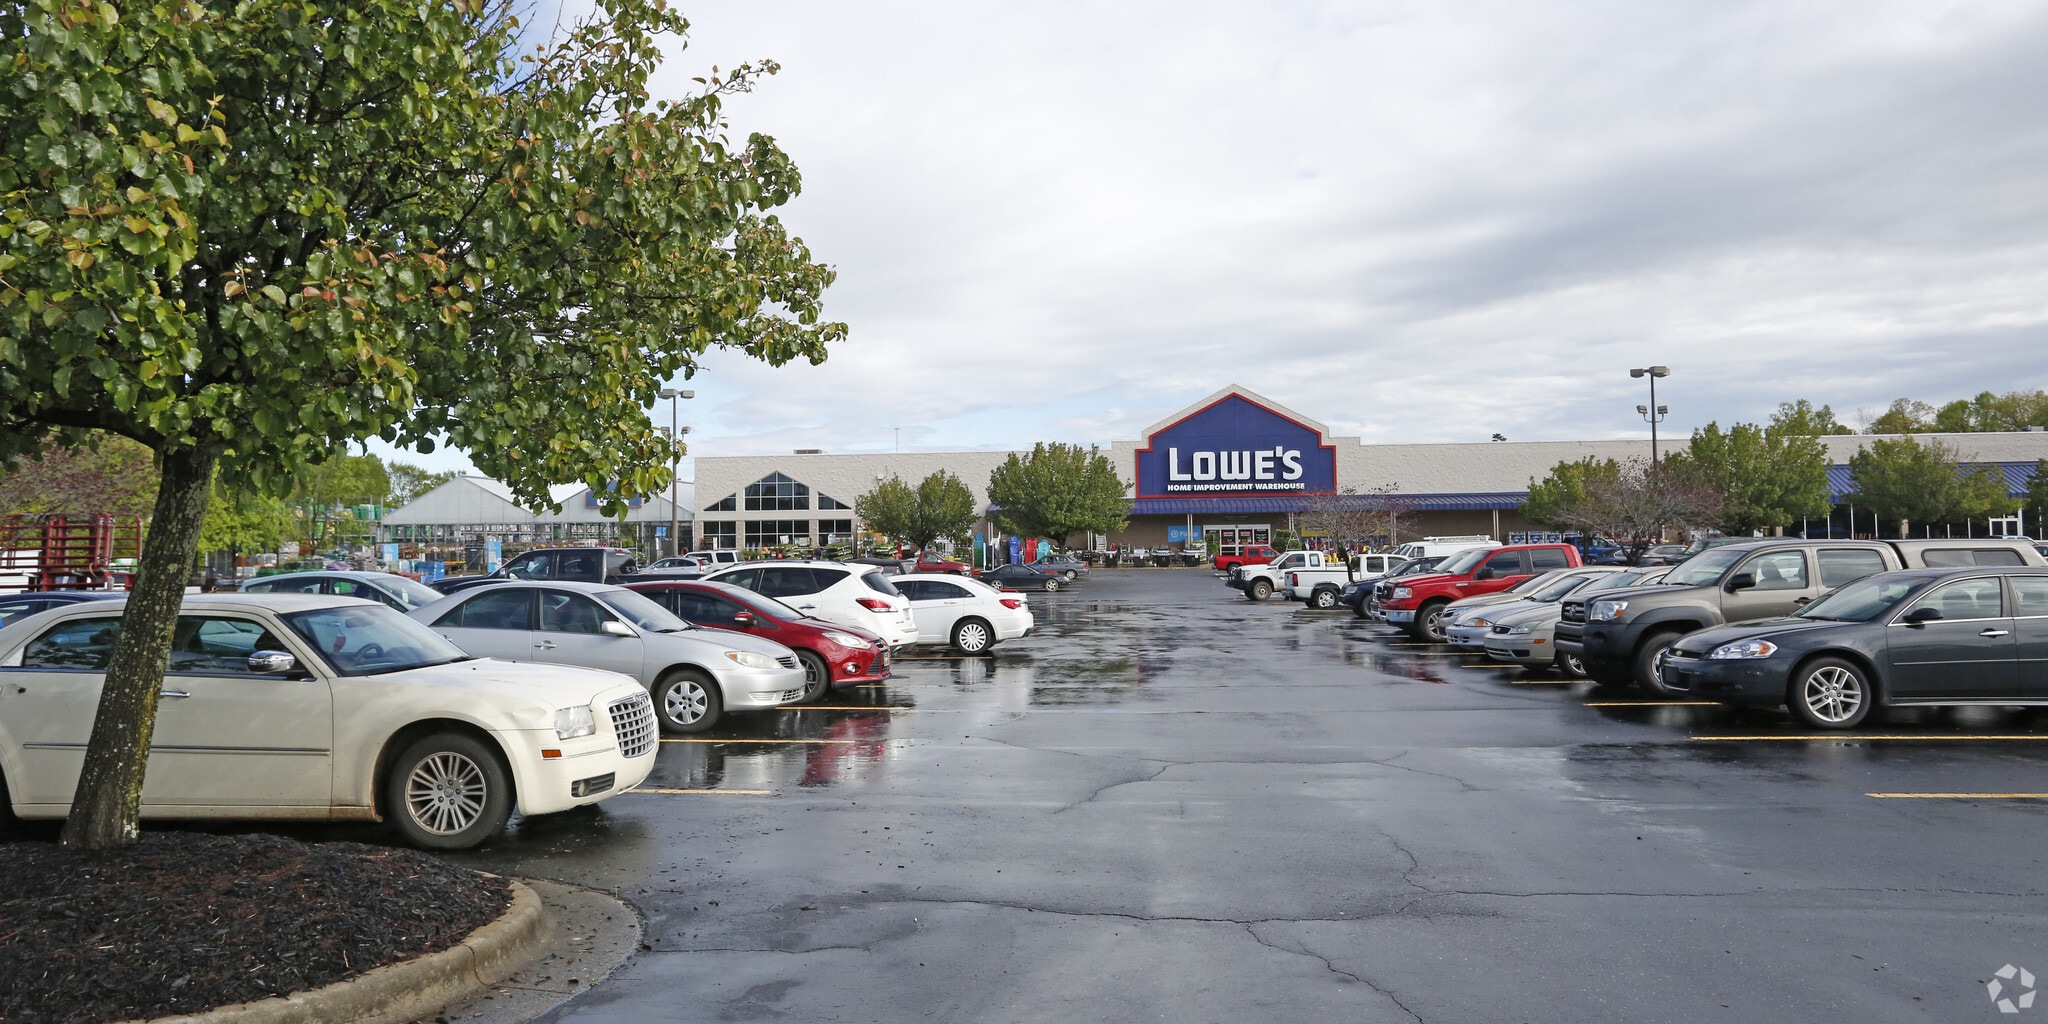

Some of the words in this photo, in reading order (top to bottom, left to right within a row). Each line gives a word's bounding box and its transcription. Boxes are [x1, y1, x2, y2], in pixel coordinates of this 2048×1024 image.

[1168, 445, 1303, 481] LOWE'S
[1167, 484, 1192, 492] HOME
[1193, 483, 1253, 491] IMPROVEMENT
[1254, 482, 1305, 491] WAREHOUSE
[1179, 530, 1199, 538] Picup
